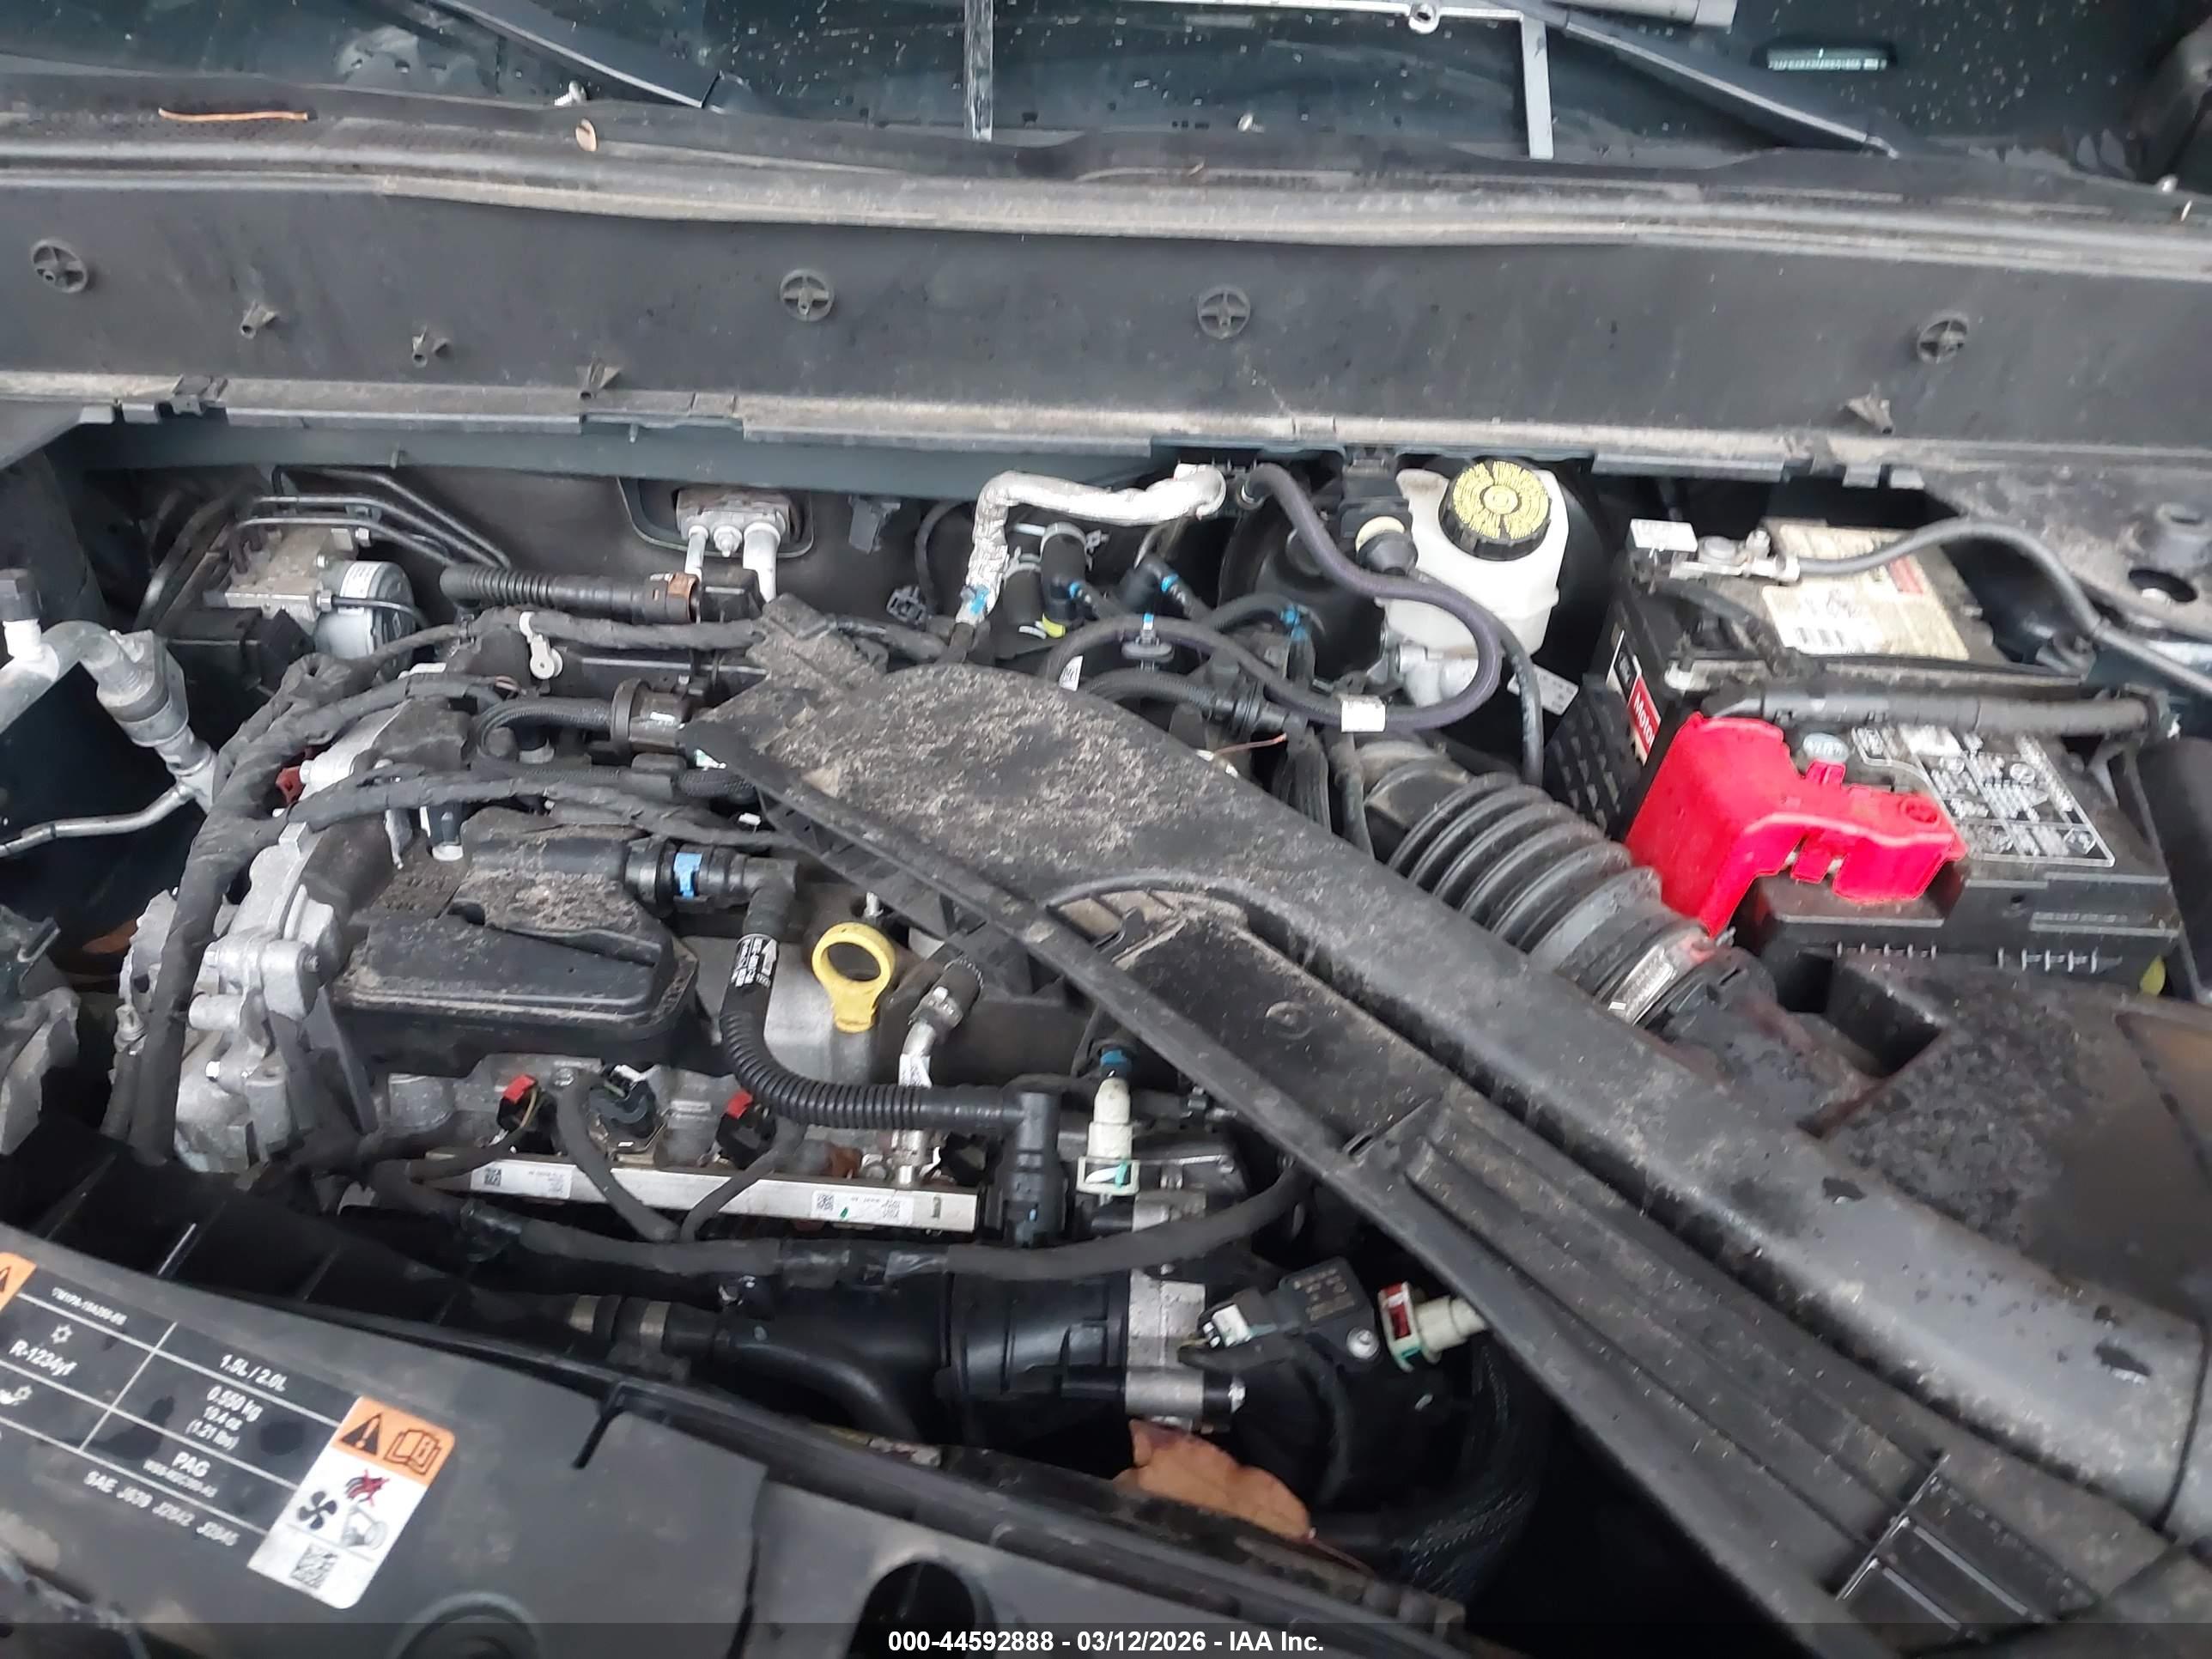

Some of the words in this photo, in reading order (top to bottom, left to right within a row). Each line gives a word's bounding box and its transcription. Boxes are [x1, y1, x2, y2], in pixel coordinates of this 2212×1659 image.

[9, 1339, 78, 1376] R-1234yf
[219, 1354, 249, 1376] 1.5L
[255, 1368, 288, 1392] 2.0L
[206, 1385, 246, 1411] 0.550
[240, 1399, 264, 1422] kg
[83, 1470, 118, 1493] SAE
[171, 1451, 211, 1478] PAG
